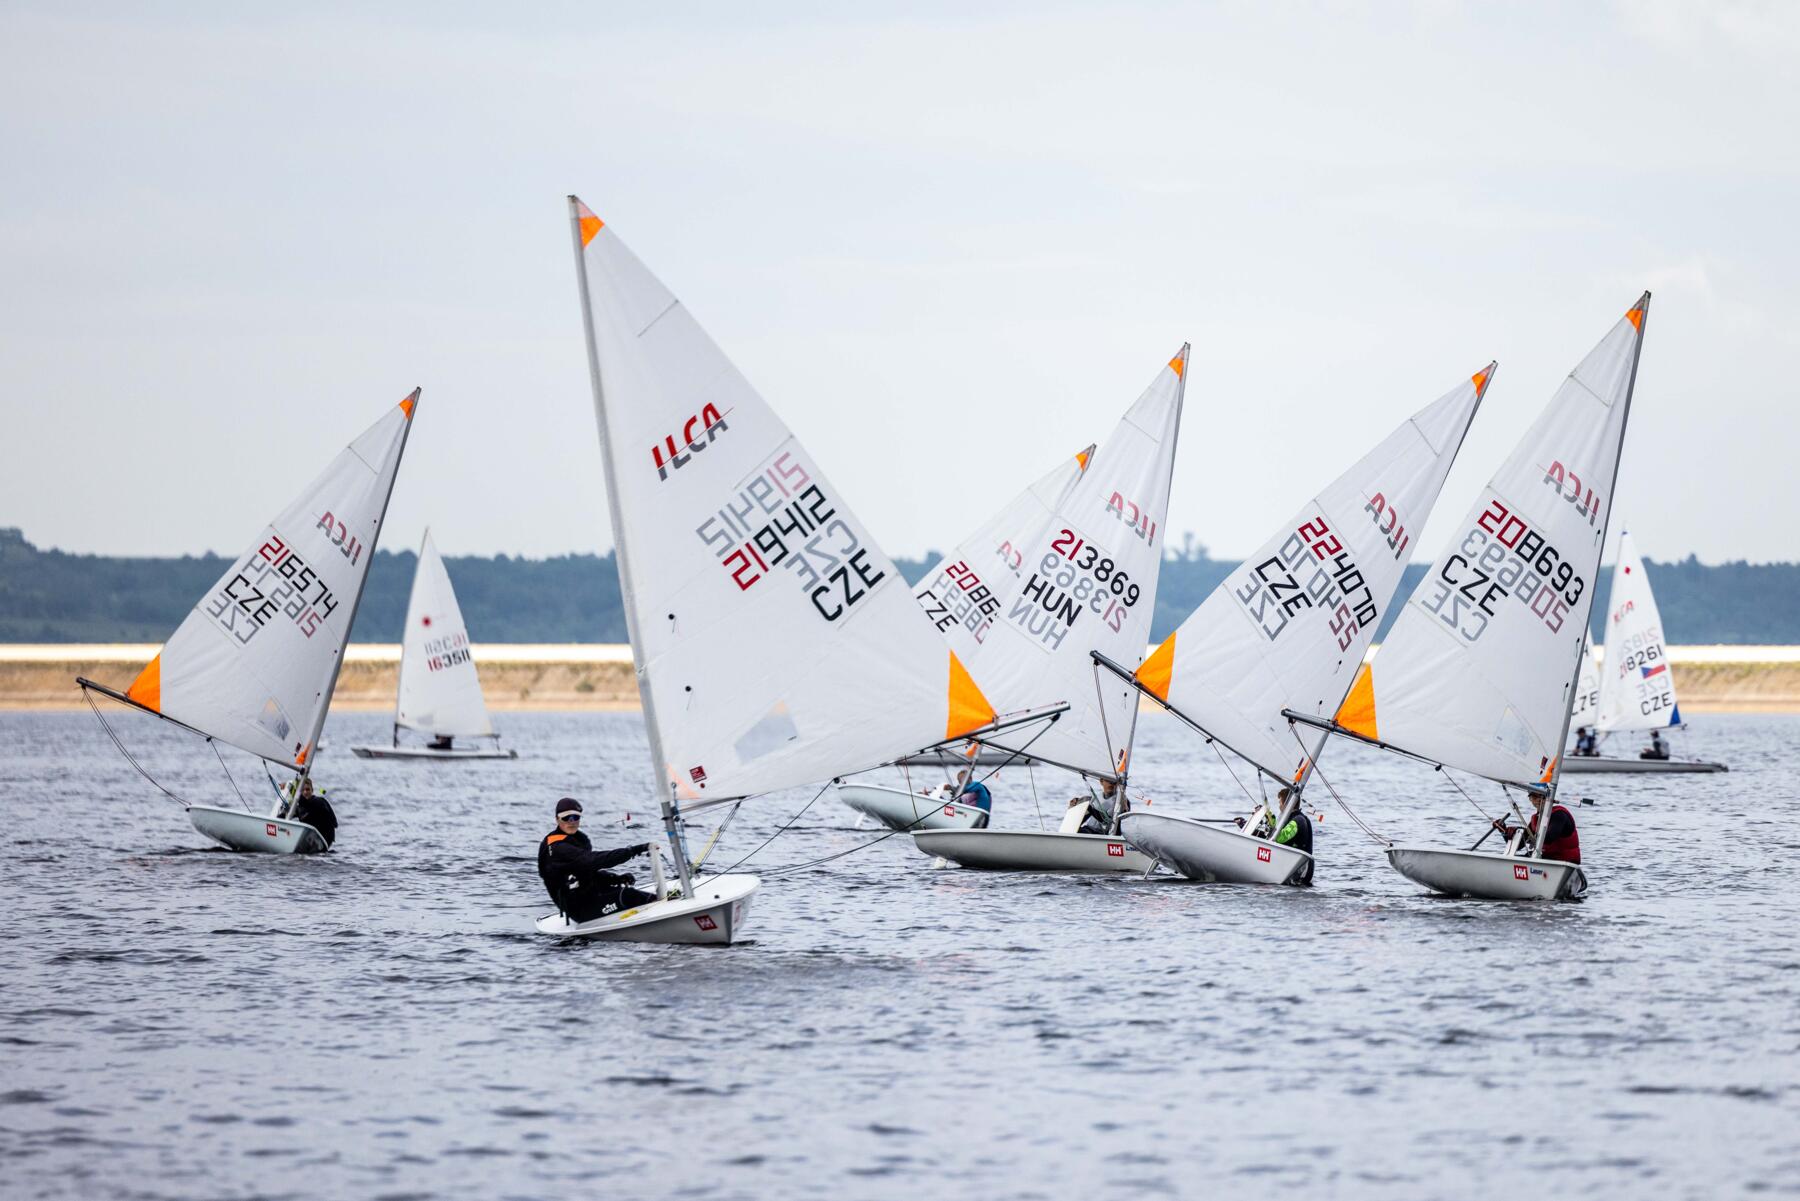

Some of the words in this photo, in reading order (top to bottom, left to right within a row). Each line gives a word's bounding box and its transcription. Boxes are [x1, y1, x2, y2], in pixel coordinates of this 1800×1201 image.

[652, 402, 729, 482] ILCA
[723, 484, 836, 591] 219412
[1051, 529, 1140, 607] 213869
[1298, 516, 1377, 629] 224070
[1477, 500, 1584, 607] 208693
[224, 574, 279, 626] CZE
[258, 536, 339, 619] 216574
[811, 548, 885, 622] CZE
[945, 561, 1001, 623] 2086
[1022, 573, 1082, 627] HUN
[1255, 556, 1313, 618] CZE
[1441, 554, 1509, 617] CZE
[1640, 691, 1673, 716] CZE
